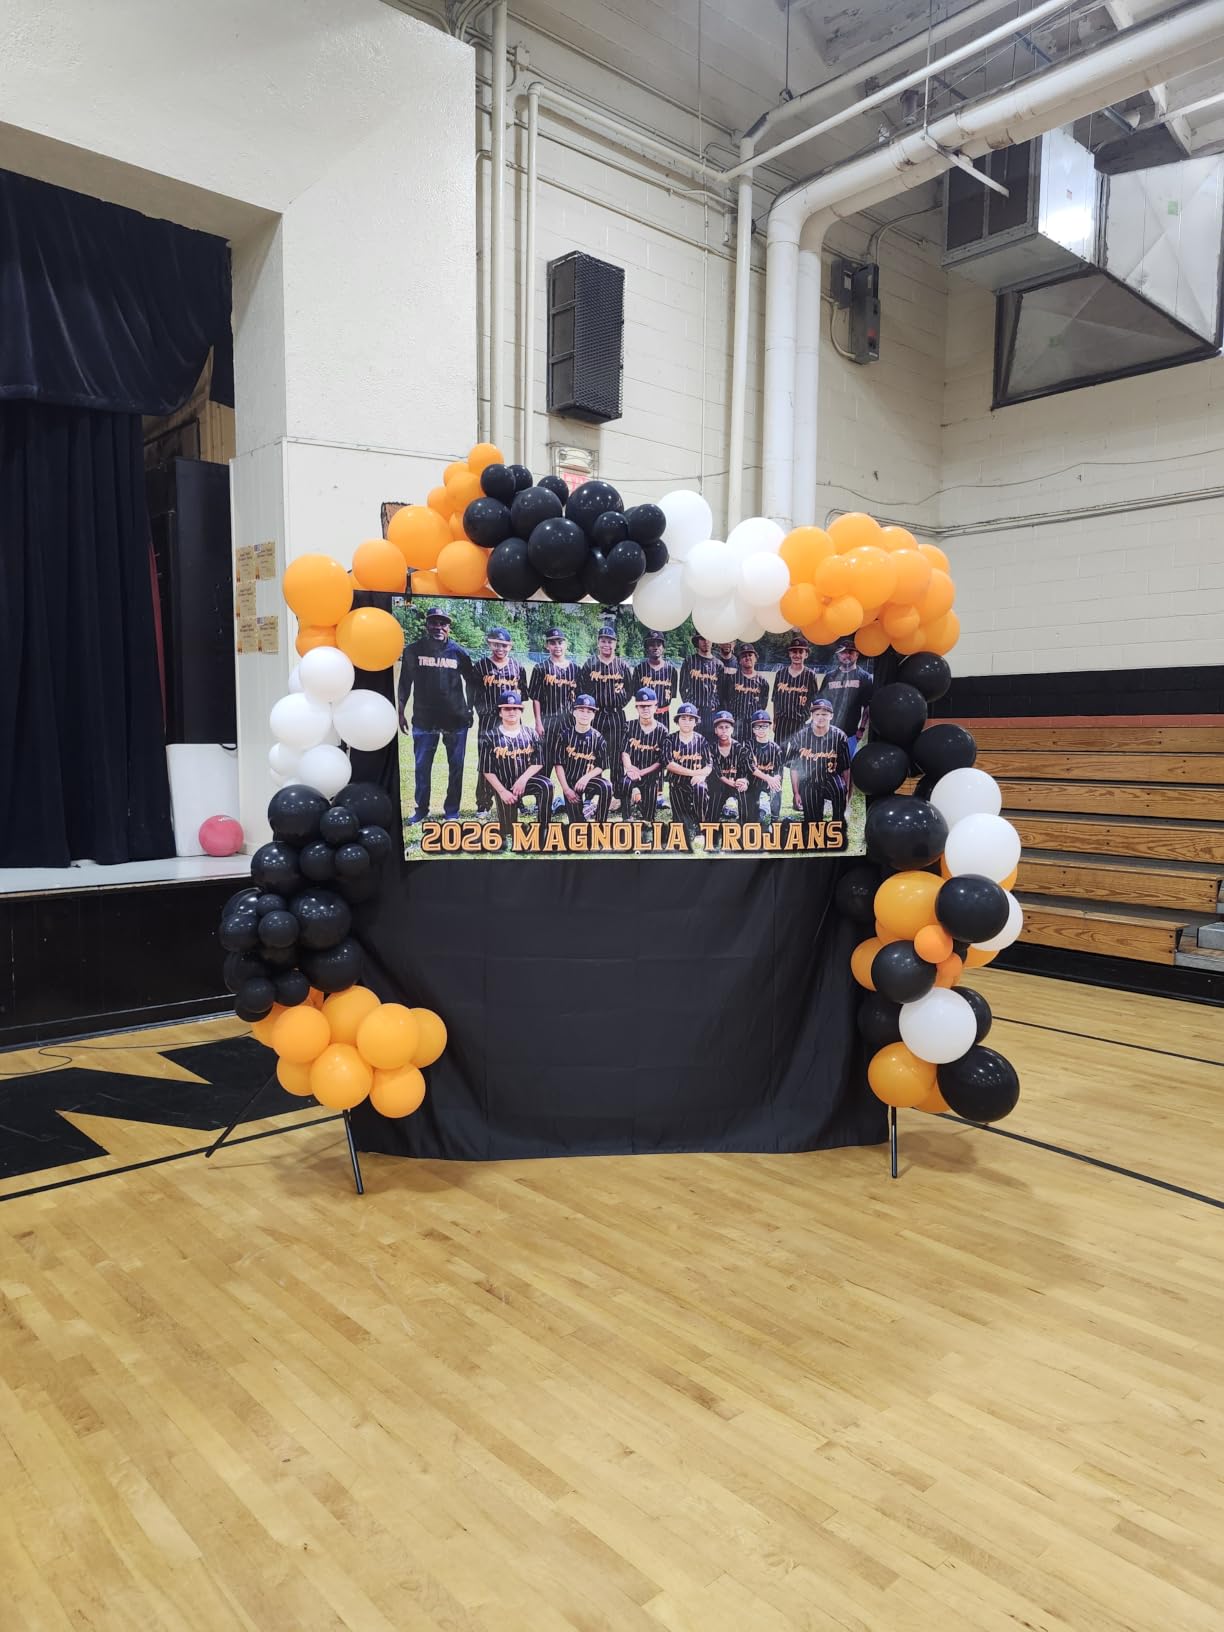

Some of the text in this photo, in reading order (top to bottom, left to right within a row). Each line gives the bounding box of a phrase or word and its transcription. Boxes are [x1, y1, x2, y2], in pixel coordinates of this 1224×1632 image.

[421, 820, 844, 852] 2026 MAGNOLIA TROJANS
